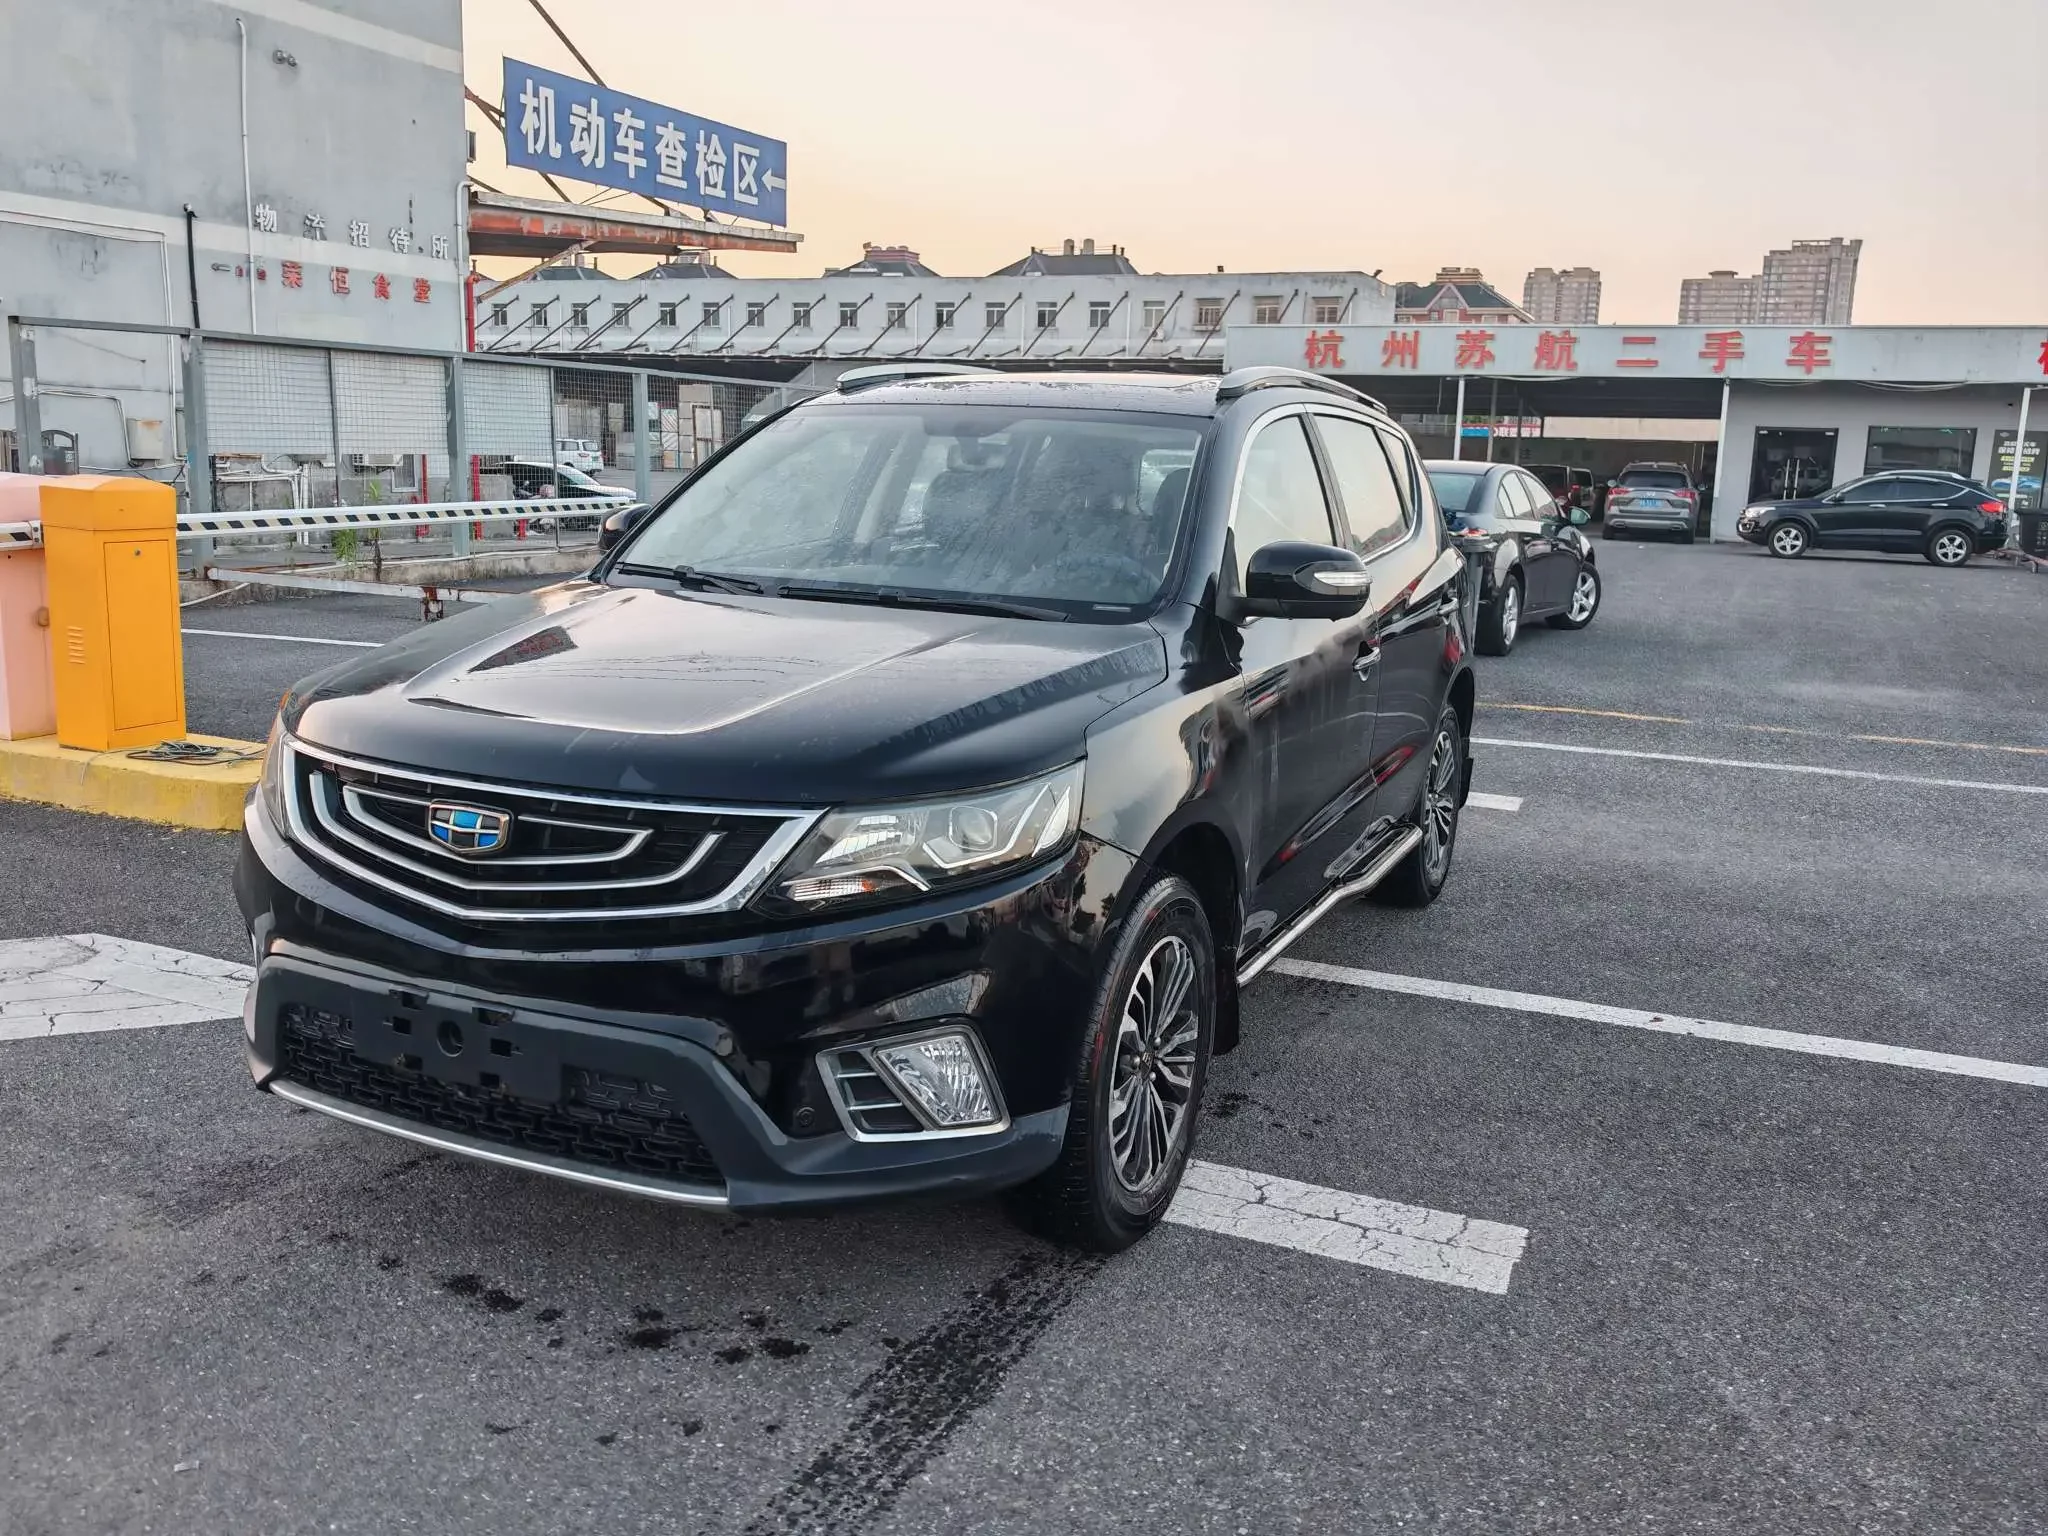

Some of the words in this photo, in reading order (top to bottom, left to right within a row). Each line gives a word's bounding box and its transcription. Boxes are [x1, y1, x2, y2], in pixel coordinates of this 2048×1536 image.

[519, 78, 761, 206] 机动车查检区
[1304, 329, 1833, 375] 杭州苏航二手车
